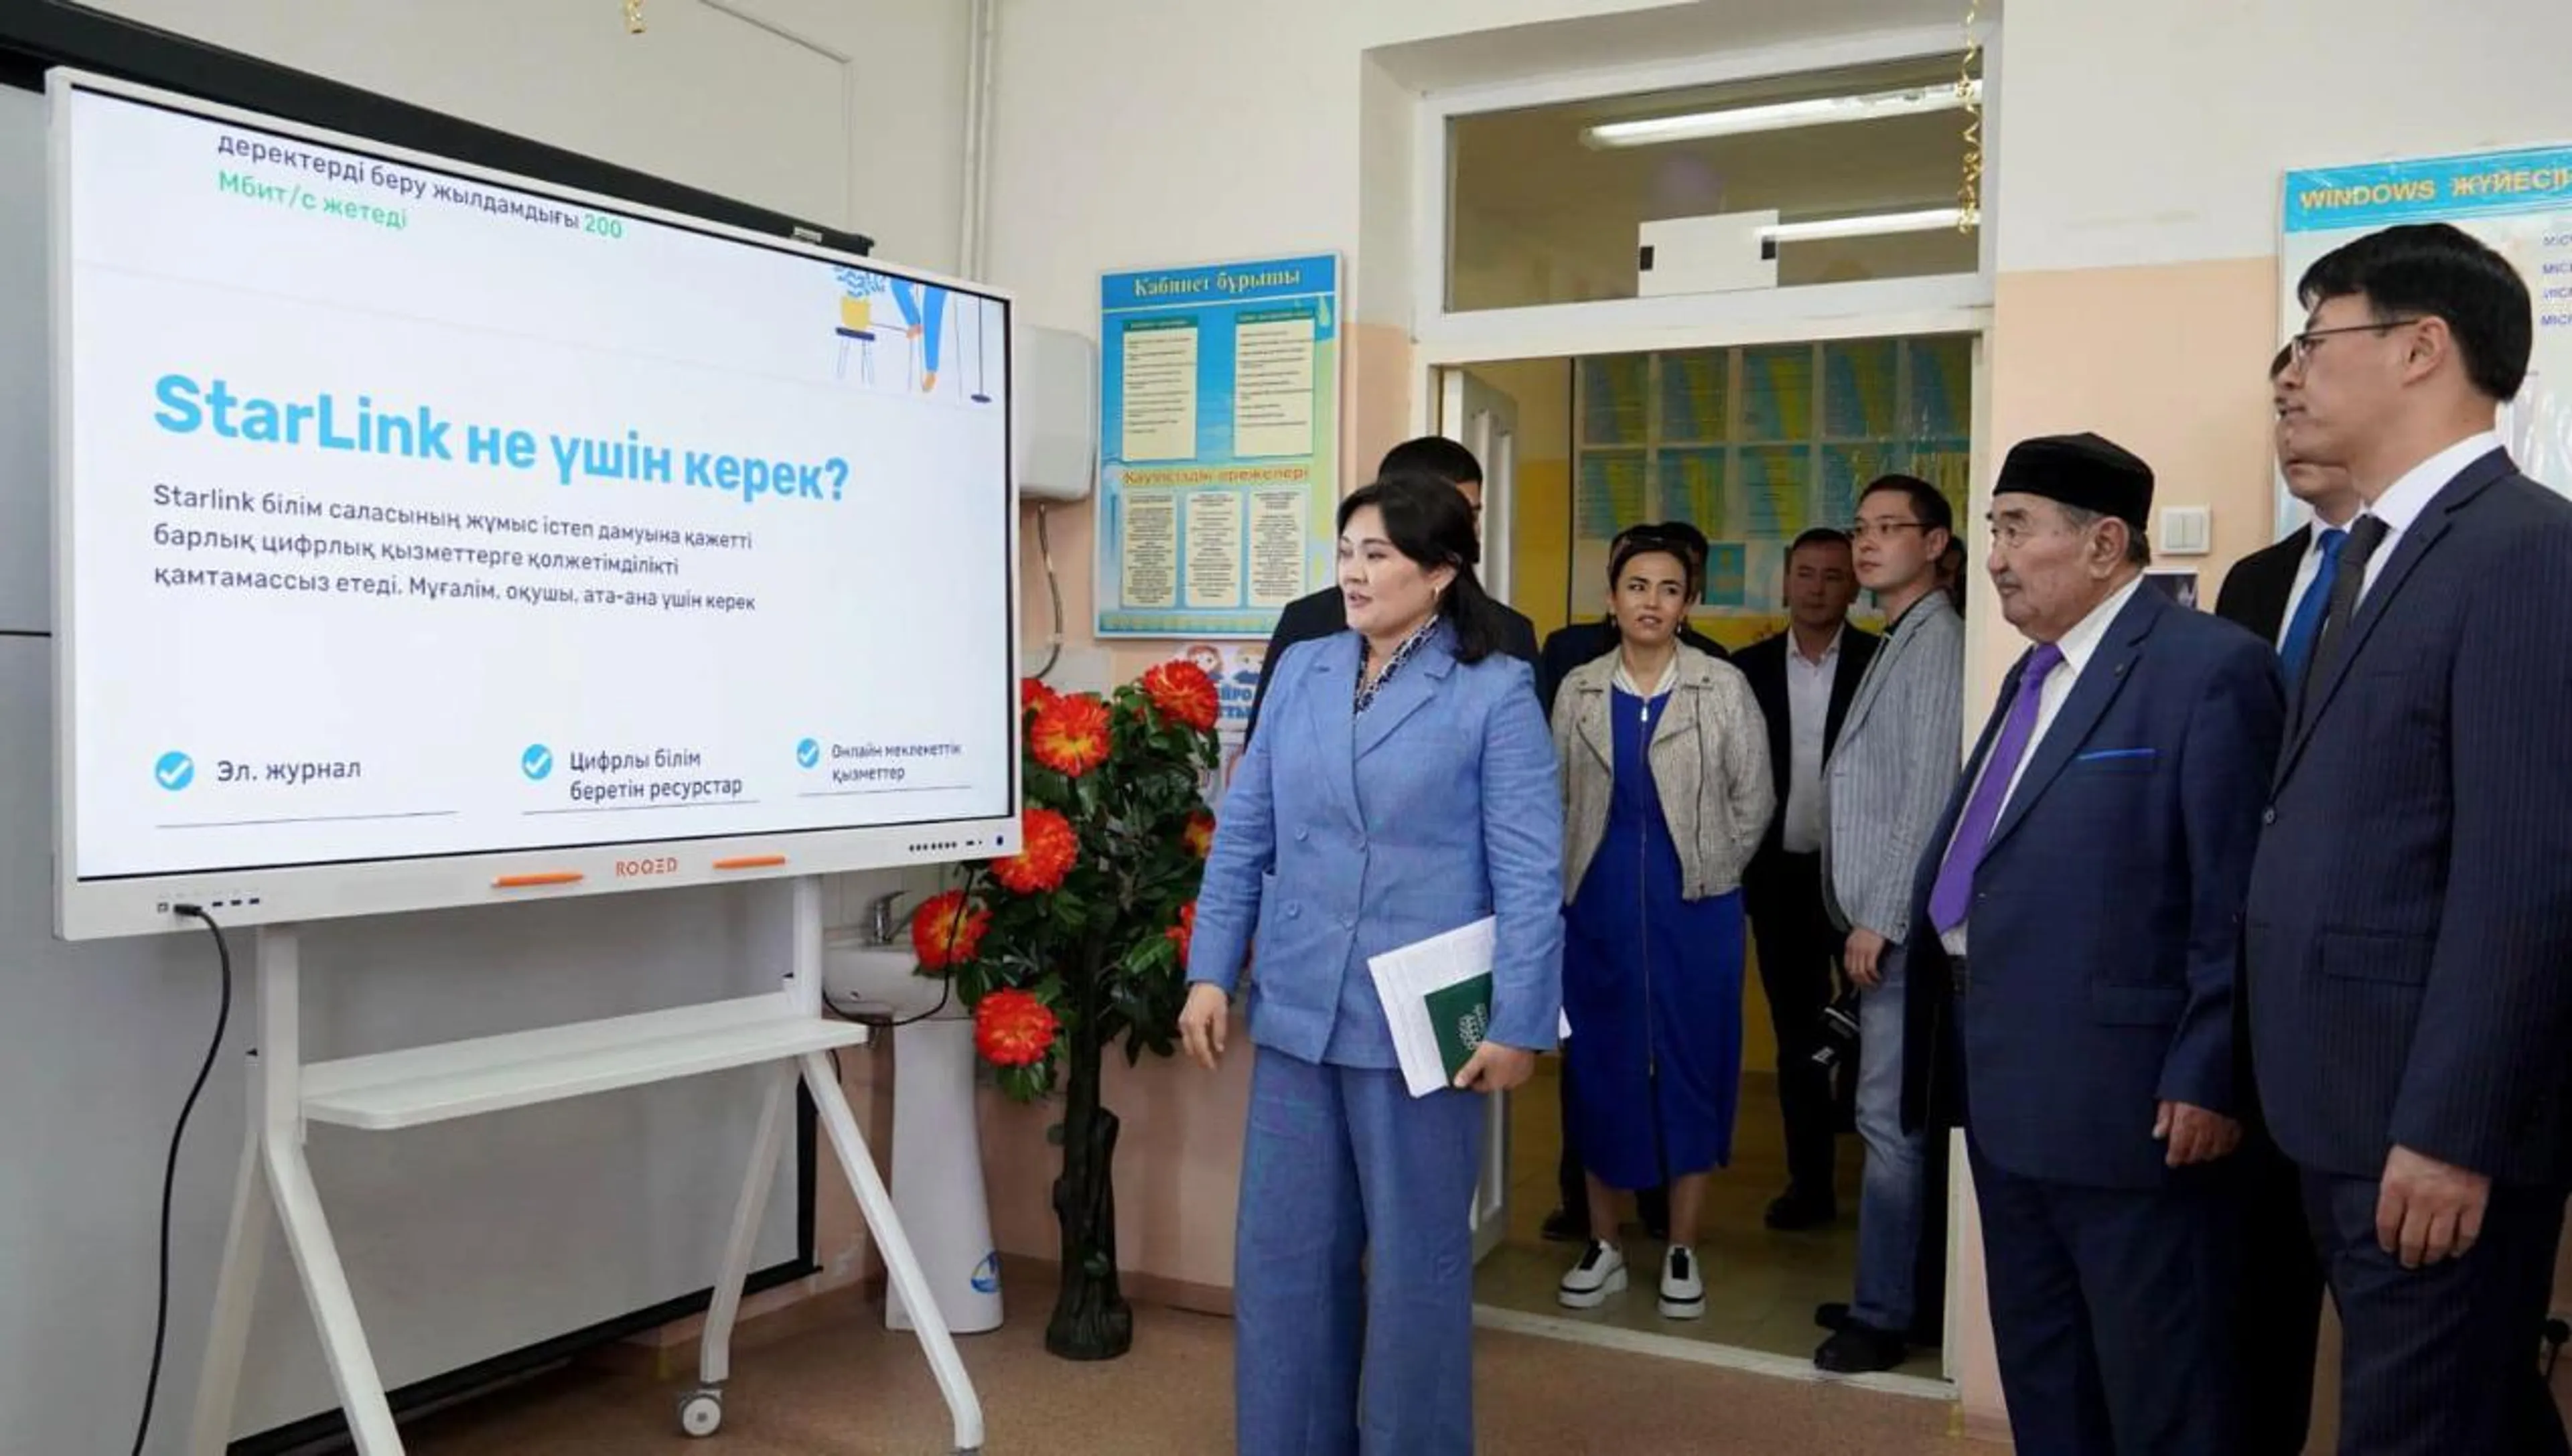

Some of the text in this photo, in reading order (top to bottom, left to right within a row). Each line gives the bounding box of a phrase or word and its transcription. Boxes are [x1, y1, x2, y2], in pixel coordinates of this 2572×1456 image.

[218, 171, 407, 228] Мбит/с жетеді
[219, 133, 622, 238] деректерді беру жылдамдығы 200
[2299, 168, 2572, 210] WINDOWS ЖҮЙЕСІ
[1134, 276, 1208, 297] Кабинет
[153, 374, 850, 502] StarLink не үшін керек?
[153, 484, 255, 512] Starlink
[262, 492, 323, 516] білім
[329, 502, 461, 530] саласының
[543, 515, 594, 538] істеп
[598, 524, 681, 546] дамуына
[685, 531, 754, 551] қажетті
[153, 523, 679, 576] барлық цифрлық қызметтерге қолжетімділікті
[154, 566, 329, 591] қамтамассыз
[336, 575, 403, 596] етеді.
[583, 588, 658, 605] ата-ана
[662, 588, 702, 610] үшін
[706, 593, 756, 611] керек
[570, 748, 701, 774] Цифрлы білім
[831, 742, 883, 758] Онлайн
[217, 759, 361, 786] Эл. журнал
[570, 778, 742, 803] беретін ресурстар
